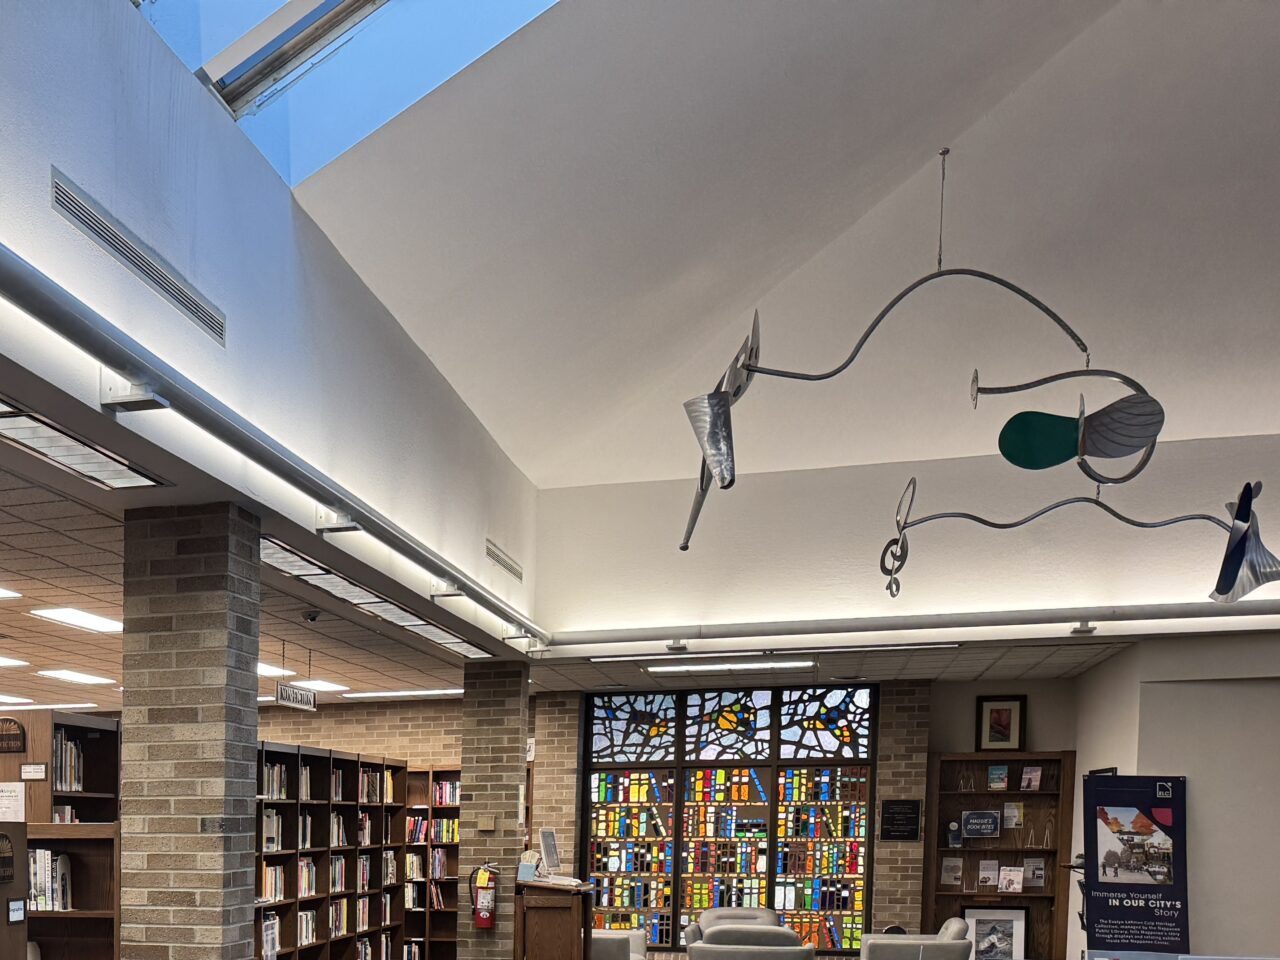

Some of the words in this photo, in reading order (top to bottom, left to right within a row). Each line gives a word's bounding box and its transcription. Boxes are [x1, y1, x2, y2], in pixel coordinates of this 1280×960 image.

[280, 686, 312, 706] NONFICTION
[1091, 890, 1127, 898] Immerse
[1123, 899, 1145, 907] OUR
[1148, 900, 1182, 909] CITY'S
[1154, 908, 1179, 918] Story
